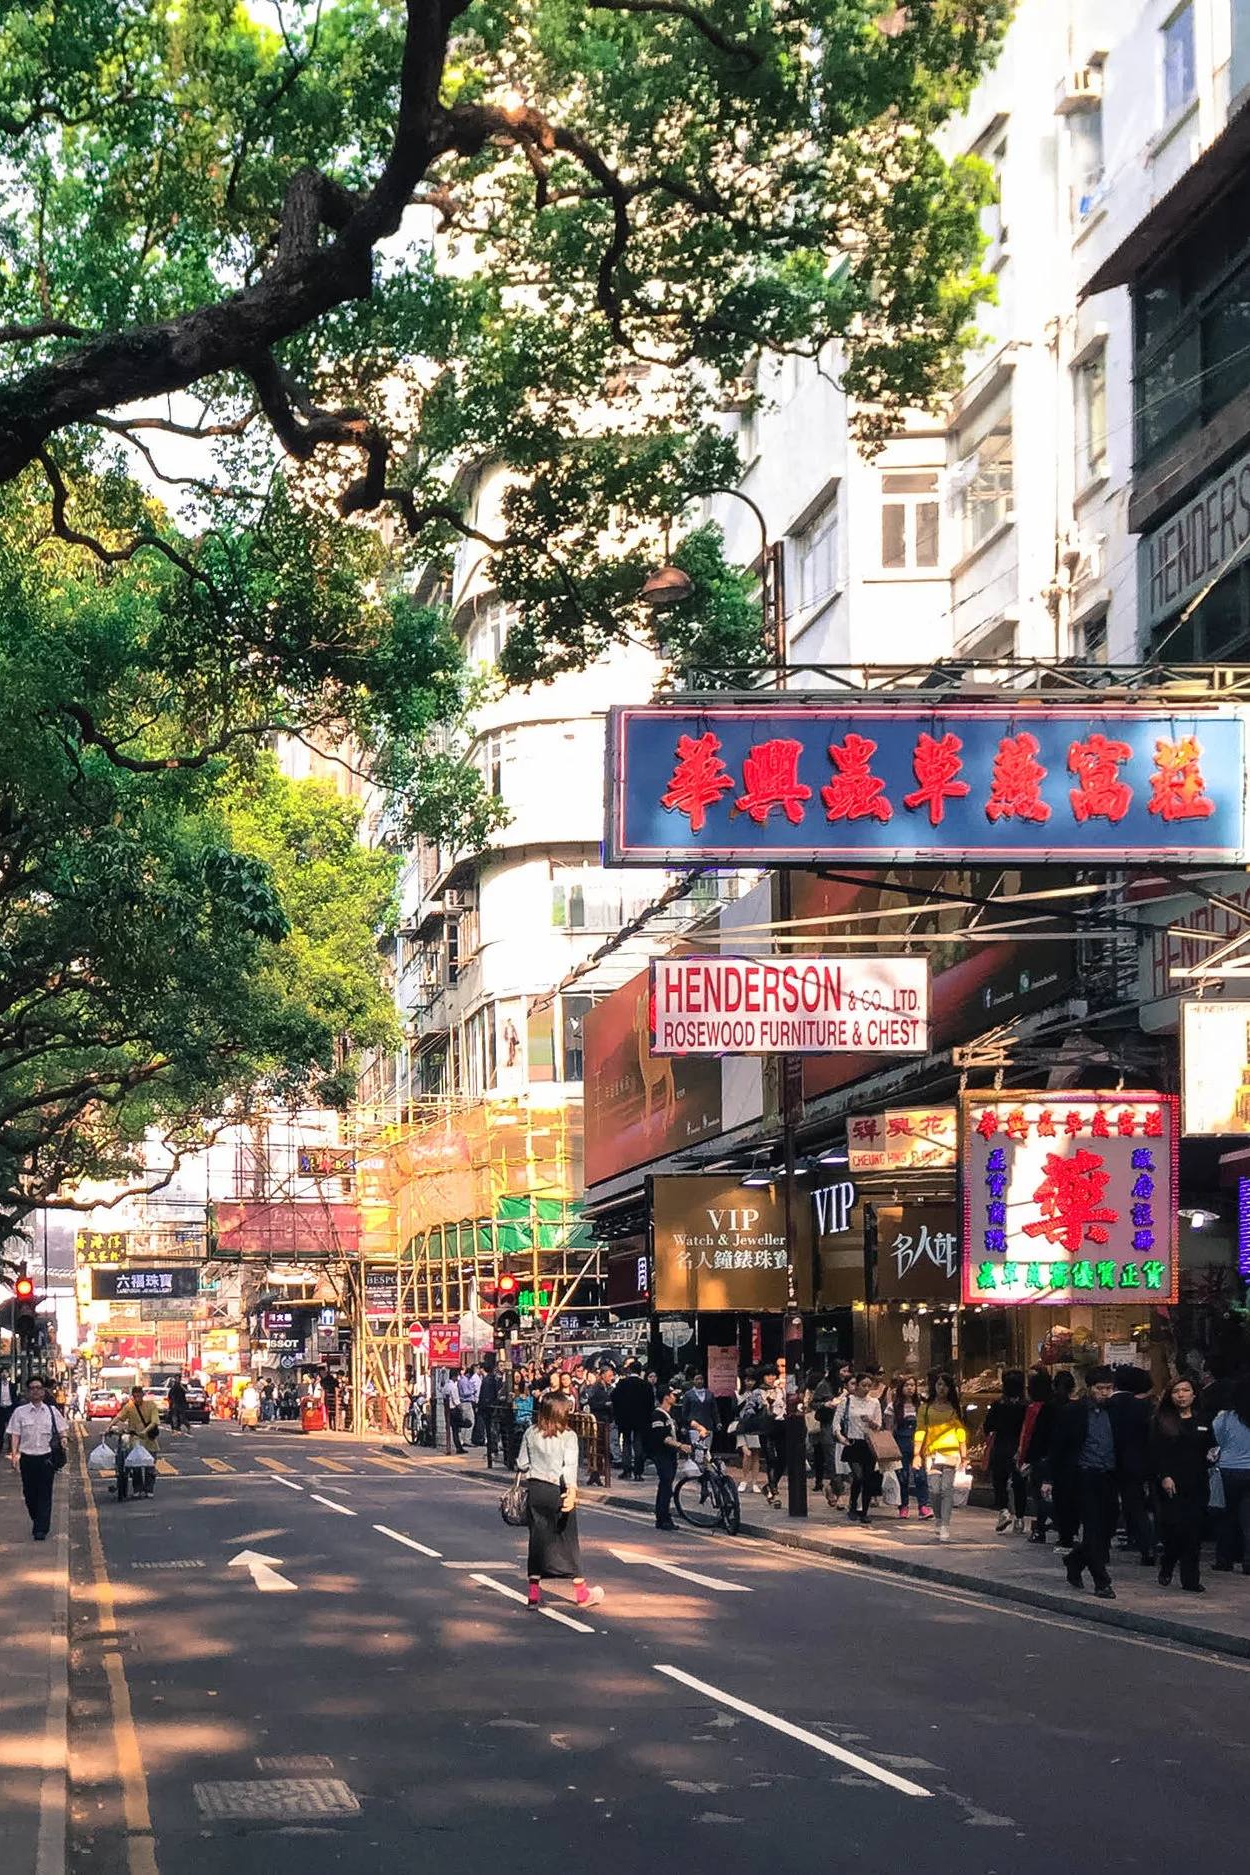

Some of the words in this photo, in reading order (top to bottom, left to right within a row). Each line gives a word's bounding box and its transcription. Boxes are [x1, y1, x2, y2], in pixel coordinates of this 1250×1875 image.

[664, 965, 842, 1012] HENDERSON
[848, 990, 857, 1011] &
[893, 989, 921, 1011] LTD.
[664, 1021, 755, 1047] ROSEWOOD
[760, 1020, 847, 1047] FURNITURE
[852, 1021, 862, 1045] &
[867, 1019, 919, 1045] CHEST
[853, 1115, 957, 1142] 祥興花
[810, 1182, 855, 1236] VIP
[1022, 1148, 1120, 1252] 藥
[707, 1209, 759, 1231] VIP
[673, 1234, 714, 1246] Watch
[718, 1234, 729, 1246] &
[732, 1234, 786, 1247] Jeweller
[116, 1274, 173, 1289] 六福珠寶
